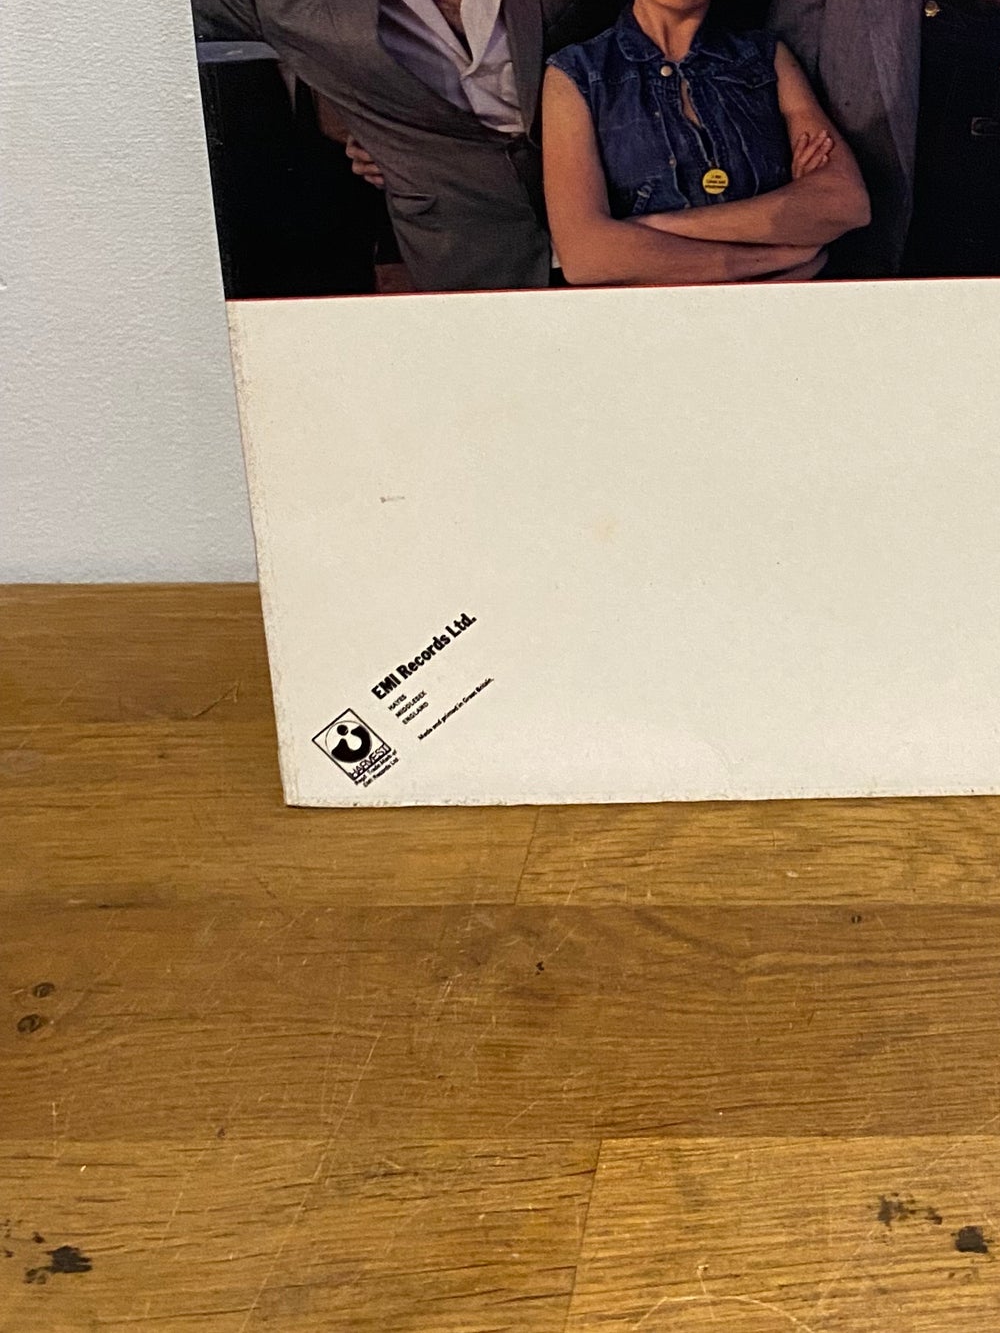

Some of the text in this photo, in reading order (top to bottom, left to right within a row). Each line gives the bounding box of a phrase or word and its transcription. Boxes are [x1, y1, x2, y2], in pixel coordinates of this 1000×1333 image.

[371, 613, 477, 700] EMI Records Ltd.
